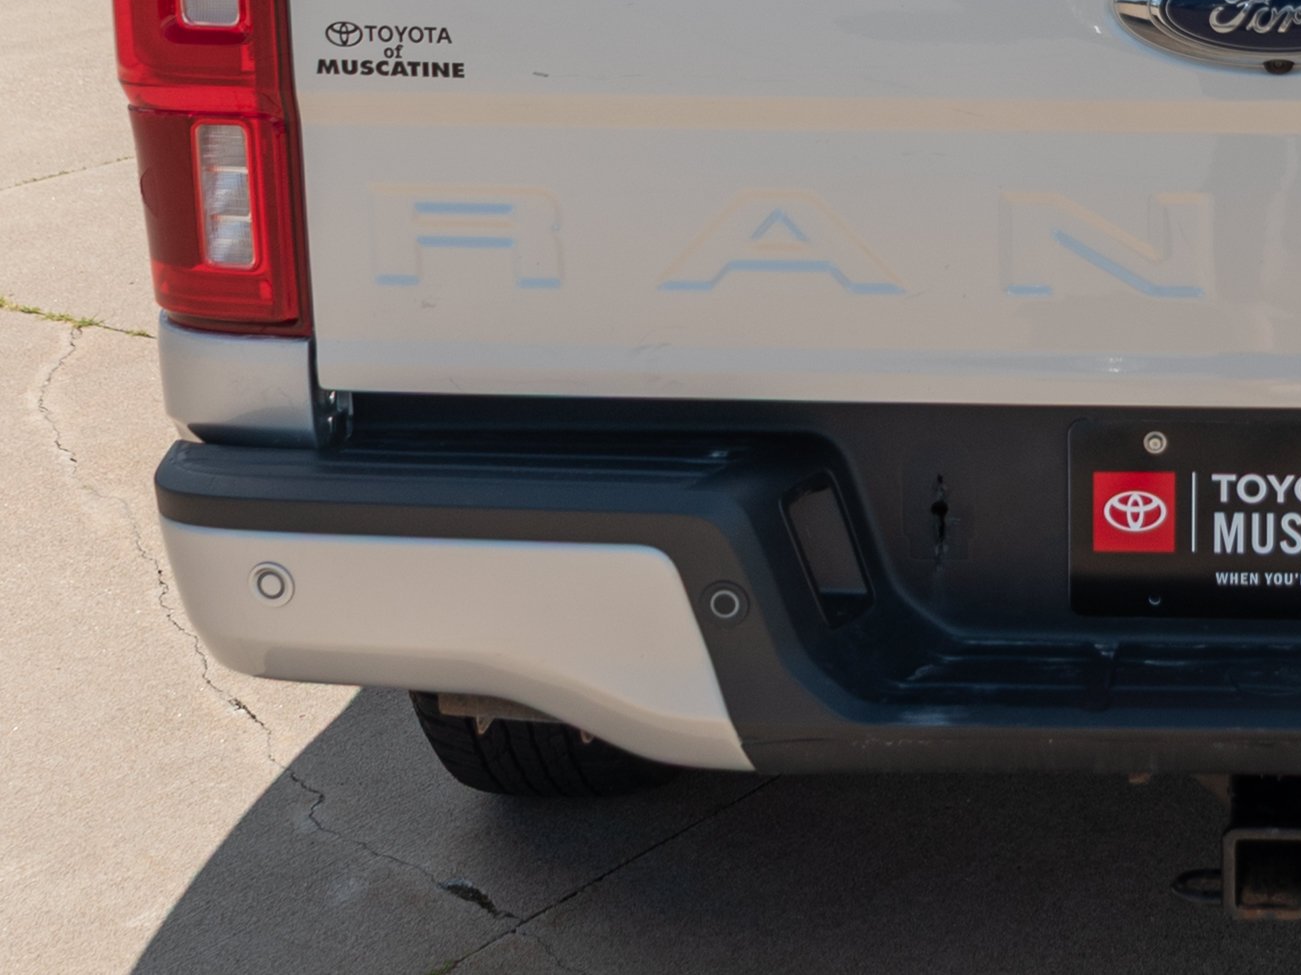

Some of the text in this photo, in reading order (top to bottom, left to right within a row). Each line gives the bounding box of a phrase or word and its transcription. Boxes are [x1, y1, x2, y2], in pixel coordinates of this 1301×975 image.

[364, 25, 453, 44] TOYOTA
[383, 44, 404, 59] of
[317, 59, 465, 78] MUSCATINE
[1216, 572, 1259, 586] WHEN
